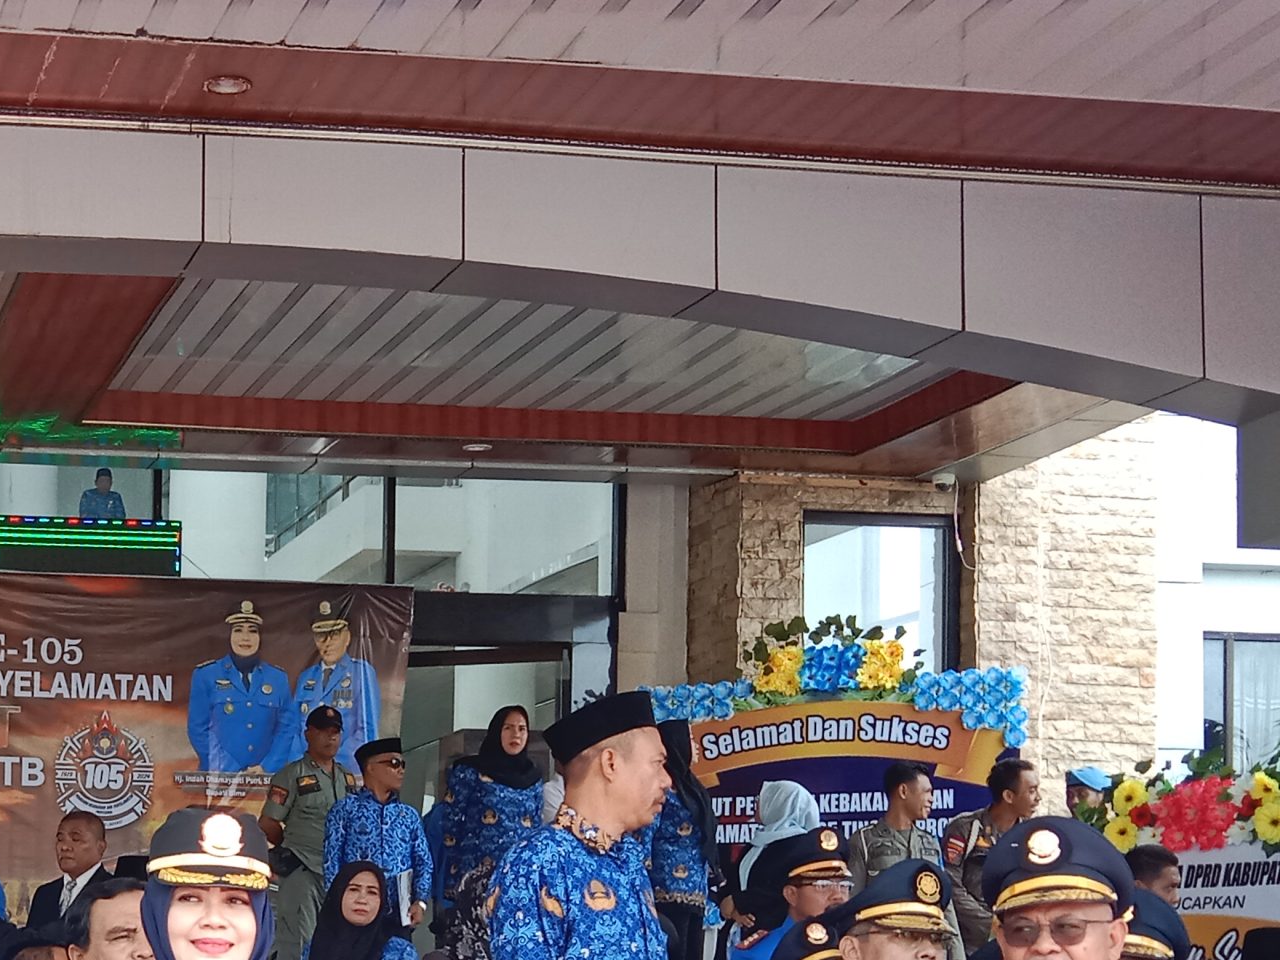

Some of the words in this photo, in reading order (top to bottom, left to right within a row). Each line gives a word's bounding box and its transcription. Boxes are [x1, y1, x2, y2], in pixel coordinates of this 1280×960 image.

[702, 718, 803, 760] Selamat
[807, 715, 855, 743] Dan
[859, 714, 951, 750] Sukses
[85, 764, 125, 789] 105
[820, 791, 888, 812] KEBAKA
[1184, 863, 1222, 888] DPRD
[1176, 895, 1246, 910] CAPKAN
